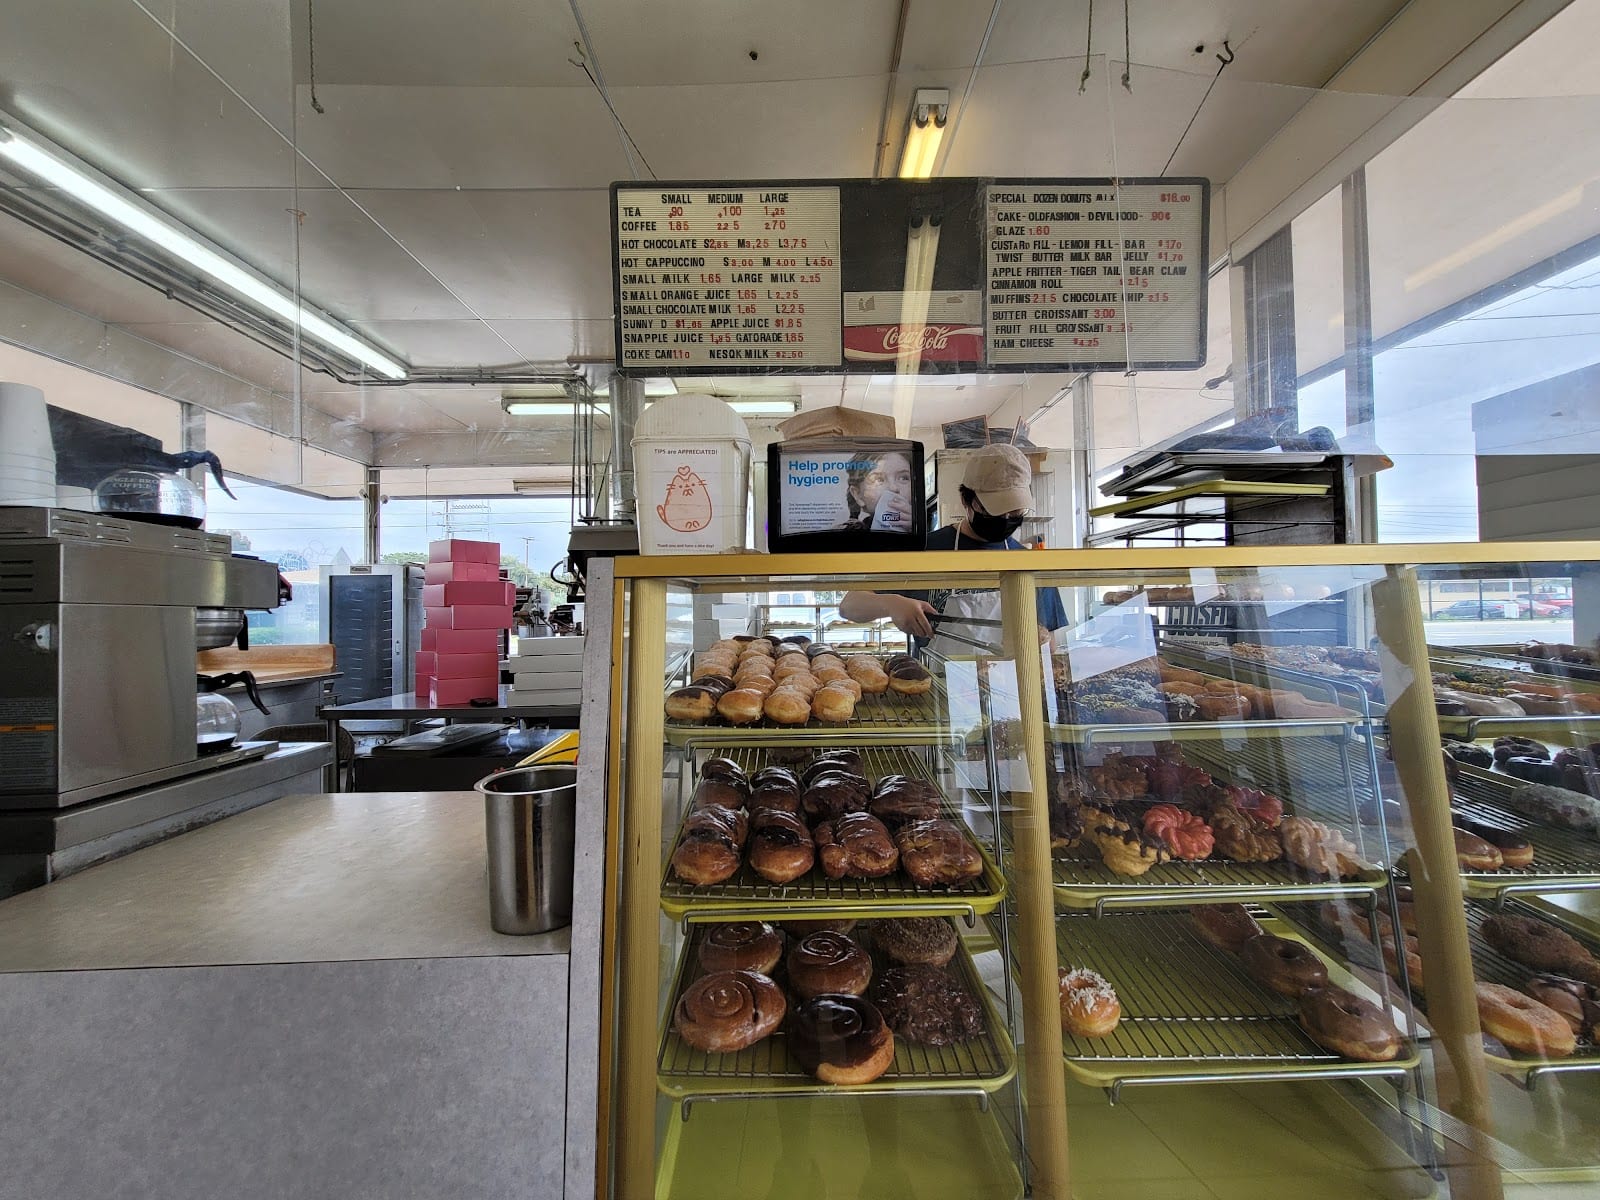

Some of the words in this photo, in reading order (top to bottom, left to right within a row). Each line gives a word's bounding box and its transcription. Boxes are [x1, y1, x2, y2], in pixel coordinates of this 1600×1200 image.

[661, 193, 692, 204] SMALL
[707, 193, 743, 204] MEDIUM
[759, 192, 789, 203] LARGE
[989, 193, 1027, 203] SPECIAL
[1033, 193, 1059, 203] DOZEN
[1060, 193, 1092, 204] DONUTS
[1095, 193, 1115, 202] MIX
[623, 206, 641, 217] TEA
[1088, 211, 1114, 221] DEVIL
[621, 221, 657, 231] COFFEE
[996, 226, 1026, 236] GLAZE
[621, 239, 640, 249] HOT
[643, 238, 697, 249] CHOCOLATE
[1059, 239, 1090, 250] LEMON
[1124, 239, 1145, 249] BAR
[621, 257, 639, 268] HOT
[645, 257, 705, 267] CAPPUCCINO
[995, 252, 1024, 263] TWIST
[1032, 252, 1064, 262] BUTTER
[1070, 252, 1090, 262] MILK
[1094, 252, 1112, 262] BAR
[1123, 251, 1149, 262] JELLY
[992, 267, 1022, 277] APPLE
[1070, 266, 1097, 276] TIGER
[1103, 266, 1121, 276] TAIL
[1129, 266, 1154, 276] BEAR
[1160, 266, 1187, 276] CLAW
[622, 273, 657, 284] SMALL
[662, 273, 690, 284] MILK
[731, 272, 763, 283] LARGE
[770, 272, 796, 283] MILK
[991, 279, 1037, 290] CINNAMON
[1041, 279, 1063, 289] ROLL
[622, 290, 658, 301] SMALL
[660, 289, 699, 300] ORANGE
[704, 289, 731, 300] JUICE
[990, 293, 1031, 304] MUFFINS
[1062, 292, 1118, 303] CHOCOLATE
[622, 304, 654, 315] SMALL
[655, 304, 706, 315] CHOCOLATE
[708, 303, 731, 314] MILK
[992, 310, 1027, 321] BUTTER
[1034, 309, 1089, 320] CROISSANT
[623, 318, 653, 329] SUNNY
[660, 318, 667, 329] D
[710, 318, 739, 329] APPLE
[742, 318, 770, 328] JUICE
[995, 324, 1022, 335] FRUIT
[1029, 324, 1049, 334] FILL
[624, 333, 669, 343] SNAPPLE
[673, 332, 704, 343] JUICE
[735, 332, 783, 343] GATORADE
[993, 339, 1014, 349] HAM
[1019, 338, 1055, 348] CHEESE
[624, 349, 650, 359] COKE
[654, 349, 672, 359] CAN
[709, 349, 742, 359] NESQK
[744, 349, 769, 358] MILK
[788, 460, 819, 473] Help
[788, 473, 840, 487] hygiene
